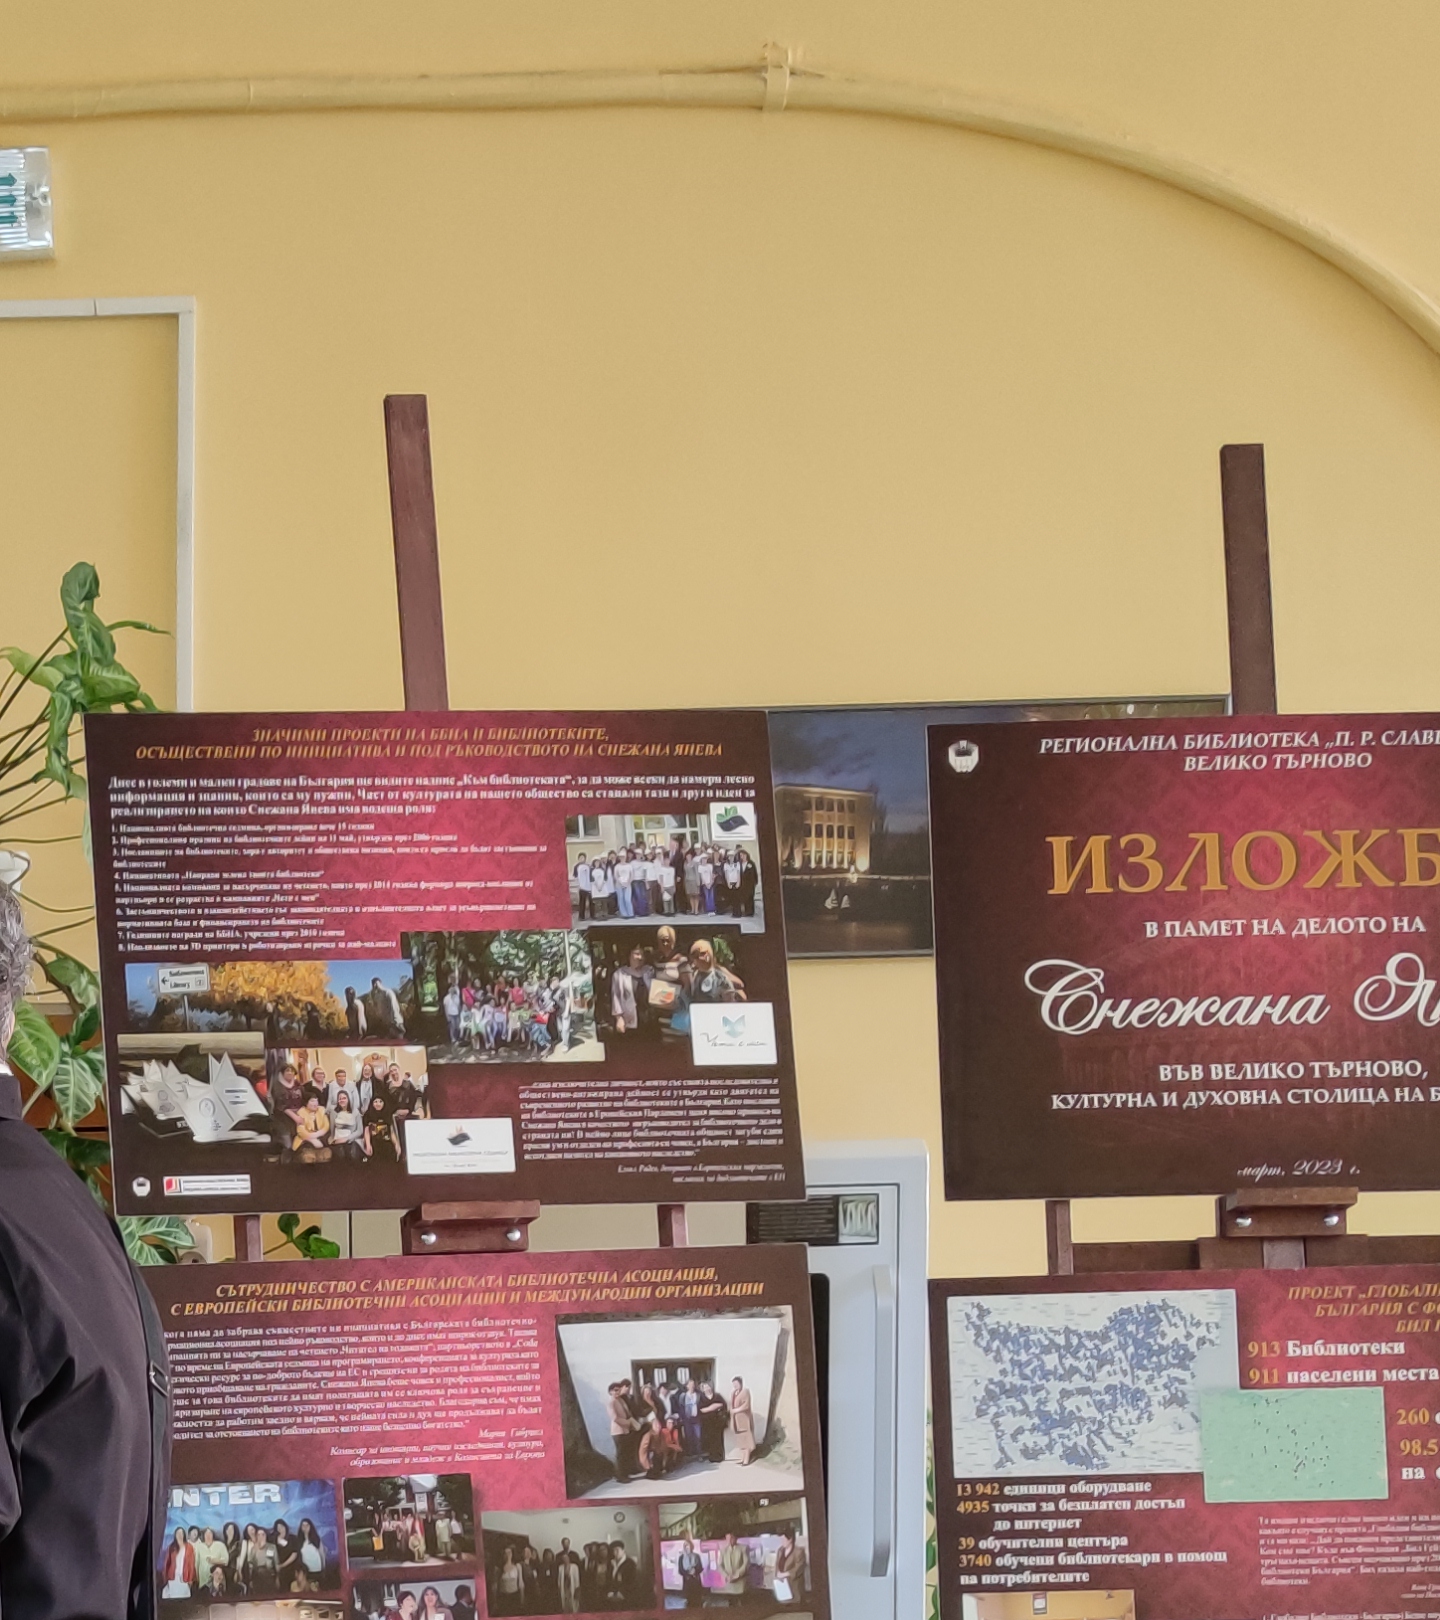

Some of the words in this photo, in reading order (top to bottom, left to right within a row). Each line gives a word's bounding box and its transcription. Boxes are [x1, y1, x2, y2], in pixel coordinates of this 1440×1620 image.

[253, 728, 326, 742] ЗНАЧИМИ
[330, 728, 401, 741] ПРОЕКТИ
[404, 728, 425, 741] НА
[472, 727, 484, 741] И
[487, 727, 611, 743] БИБЛИОТЕКИТЕ,
[1040, 735, 1177, 753] РЕГИОНАЛНА
[1184, 731, 1319, 749] БИБЛИОТЕКА
[1321, 731, 1356, 748] „П.
[1358, 730, 1376, 747] Р.
[136, 745, 256, 760] ОСЪЩЕСТВЕНИ
[259, 745, 282, 758] ПО
[286, 744, 390, 758] ИНИЦИАТИВА
[394, 744, 406, 757] И
[409, 744, 441, 757] ПОД
[445, 744, 569, 757] РЪКОВОДСТВОТО
[573, 743, 593, 756] НА
[597, 743, 670, 756] СНЕЖАНА
[673, 743, 722, 756] ЯНЕВА
[1184, 754, 1267, 771] ВЕЛИКО
[1272, 752, 1372, 769] ТЪРНОВО
[1144, 921, 1158, 938] В
[1164, 919, 1247, 937] ПАМЕТ
[1251, 918, 1286, 935] НА
[1291, 916, 1387, 938] ДЕЛОТО
[1391, 915, 1426, 933] НА
[1024, 959, 1330, 1034] Снежана
[1159, 1064, 1204, 1081] ВЪВ
[1209, 1062, 1304, 1080] ВЕЛИКО
[1309, 1059, 1427, 1079] ТЪРНОВО,
[1051, 1092, 1157, 1109] КУЛТУРНА
[1161, 1091, 1178, 1107] И
[1183, 1089, 1282, 1108] ДУХОВНА
[1287, 1087, 1389, 1104] СТОЛИЦА
[1394, 1086, 1425, 1102] НА
[216, 1280, 356, 1298] СЪТРУДНИЧЕСТВО
[359, 1279, 371, 1292] С
[373, 1275, 502, 1291] АМЕРИКАНСКАТА
[507, 1271, 617, 1286] БИБЛИОТЕЧНА
[621, 1267, 718, 1283] АСОЦИАЦИЯ,
[170, 1303, 181, 1316] С
[184, 1297, 288, 1315] ЕВРОПЕЙСКИ
[291, 1295, 406, 1311] БИБЛИОТЕЧНИ
[410, 1291, 506, 1307] АСОЦИАЦИИ
[508, 1290, 521, 1303] И
[525, 1286, 652, 1303] МЕЖДУНАРОДНИ
[655, 1280, 764, 1298] ОРГАНИЗАЦИИ
[1288, 1285, 1356, 1302] ПРОЕКТ
[1315, 1302, 1402, 1318] БЪЛГАРИЯ
[1407, 1301, 1419, 1315] С
[1395, 1318, 1431, 1333] БИЛ
[1248, 1340, 1282, 1360] 913
[1286, 1339, 1405, 1359] Библиотеки
[1249, 1365, 1285, 1384] 911
[1287, 1365, 1376, 1383] населени
[1382, 1368, 1439, 1382] места
[1397, 1407, 1429, 1425] 260
[1400, 1438, 1438, 1456] 98.5
[1401, 1467, 1425, 1480] на
[168, 1484, 281, 1507] NTER
[957, 1483, 972, 1496] 13
[975, 1482, 1000, 1495] 942
[1003, 1484, 1066, 1496] единици
[1069, 1480, 1151, 1497] оборудване
[956, 1500, 989, 1513] 4935
[991, 1502, 1037, 1513] точки
[1039, 1501, 1055, 1512] за
[1058, 1498, 1131, 1511] безплатен
[1134, 1498, 1185, 1510] достъп
[992, 1520, 1011, 1531] до
[1014, 1518, 1082, 1532] интернет
[958, 1538, 976, 1551] 39
[978, 1538, 1066, 1555] обучителни
[1067, 1536, 1128, 1554] центъра
[959, 1554, 992, 1567] 3740
[995, 1554, 1054, 1570] обучени
[1057, 1552, 1160, 1566] библиотекари
[1164, 1552, 1173, 1563] в
[1177, 1551, 1227, 1562] помощ
[959, 1574, 978, 1585] на
[981, 1571, 1089, 1587] потребителите
